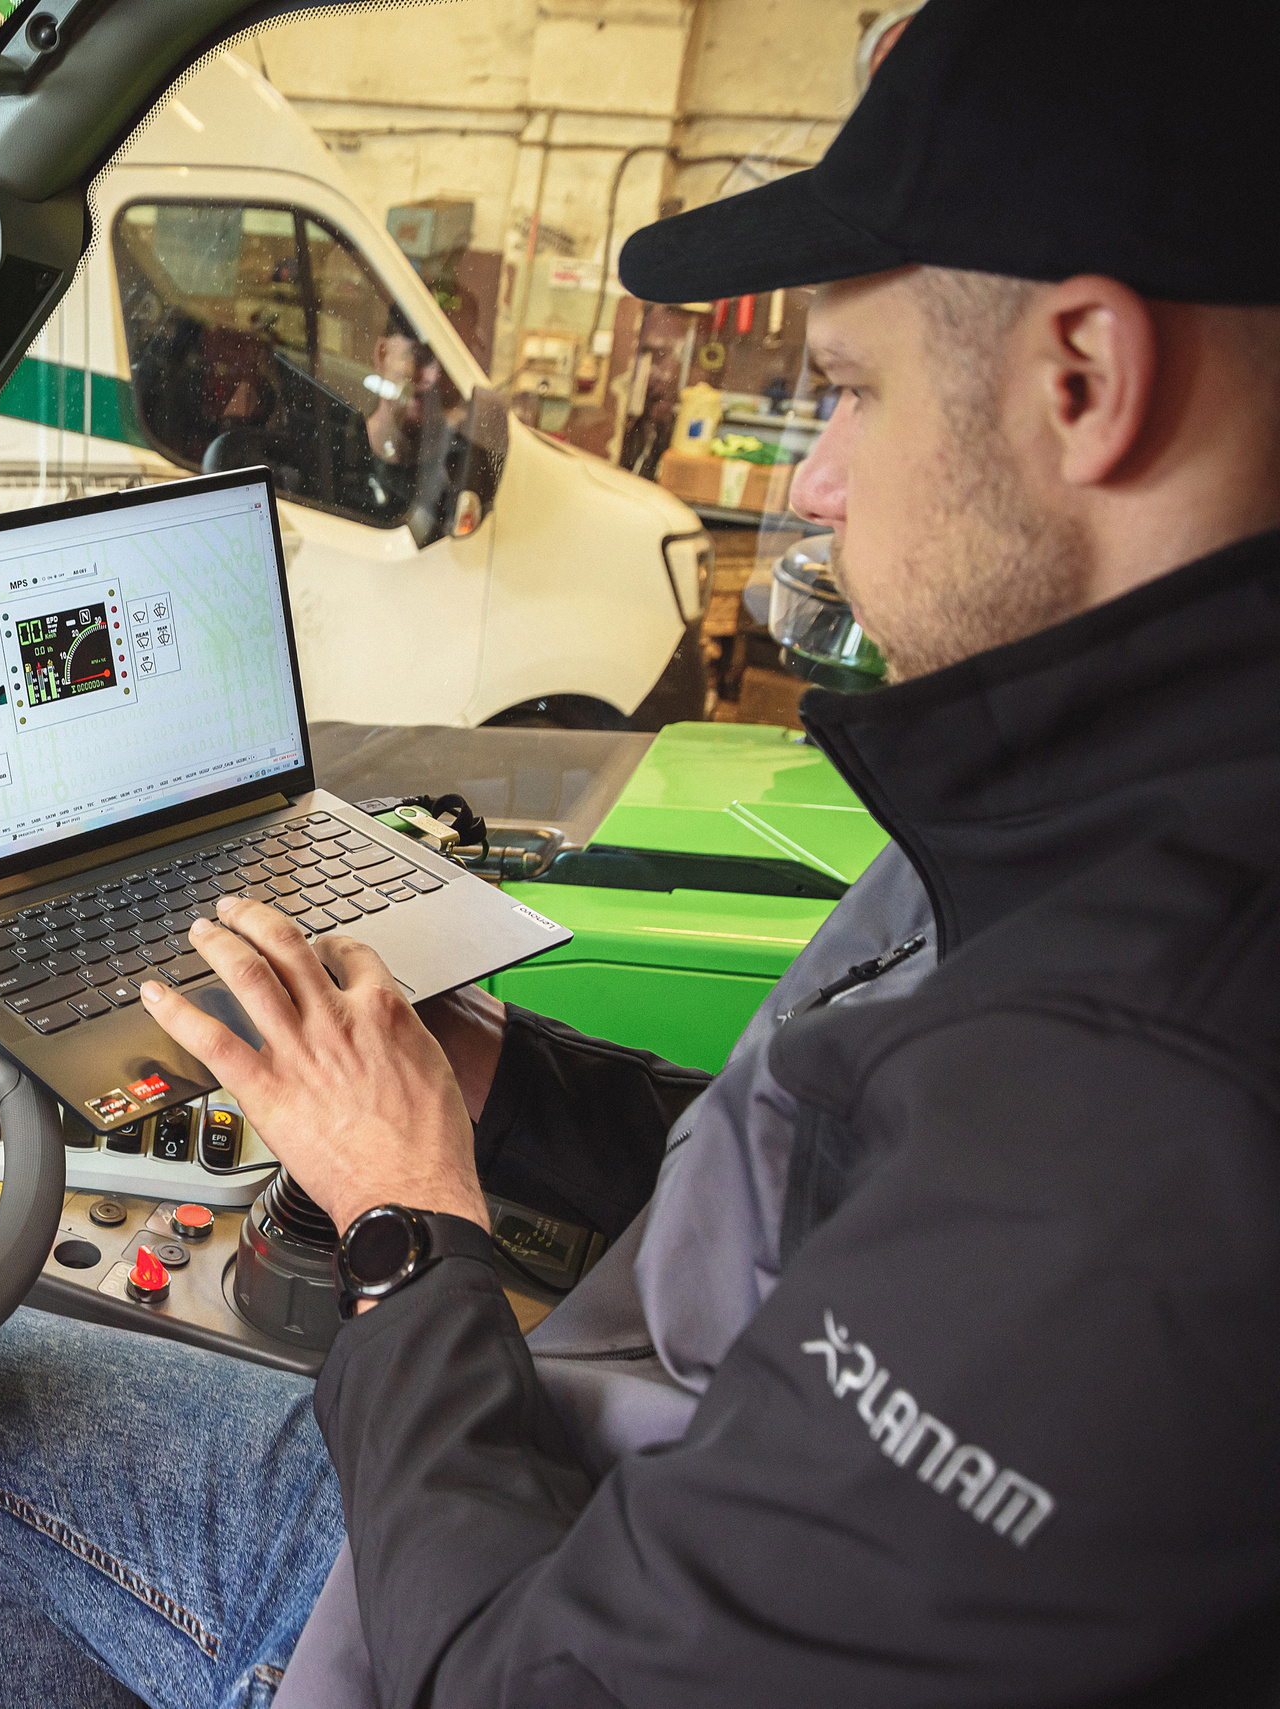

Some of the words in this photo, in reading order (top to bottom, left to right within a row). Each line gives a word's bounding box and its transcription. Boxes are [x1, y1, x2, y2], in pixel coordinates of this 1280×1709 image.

[10, 579, 28, 590] MPS
[72, 629, 80, 637] 20
[60, 652, 67, 660] 10
[520, 908, 555, 929] Lenovo
[14, 998, 30, 1006] Shift
[212, 1134, 227, 1142] EPD
[832, 1339, 1056, 1548] PLANAM
